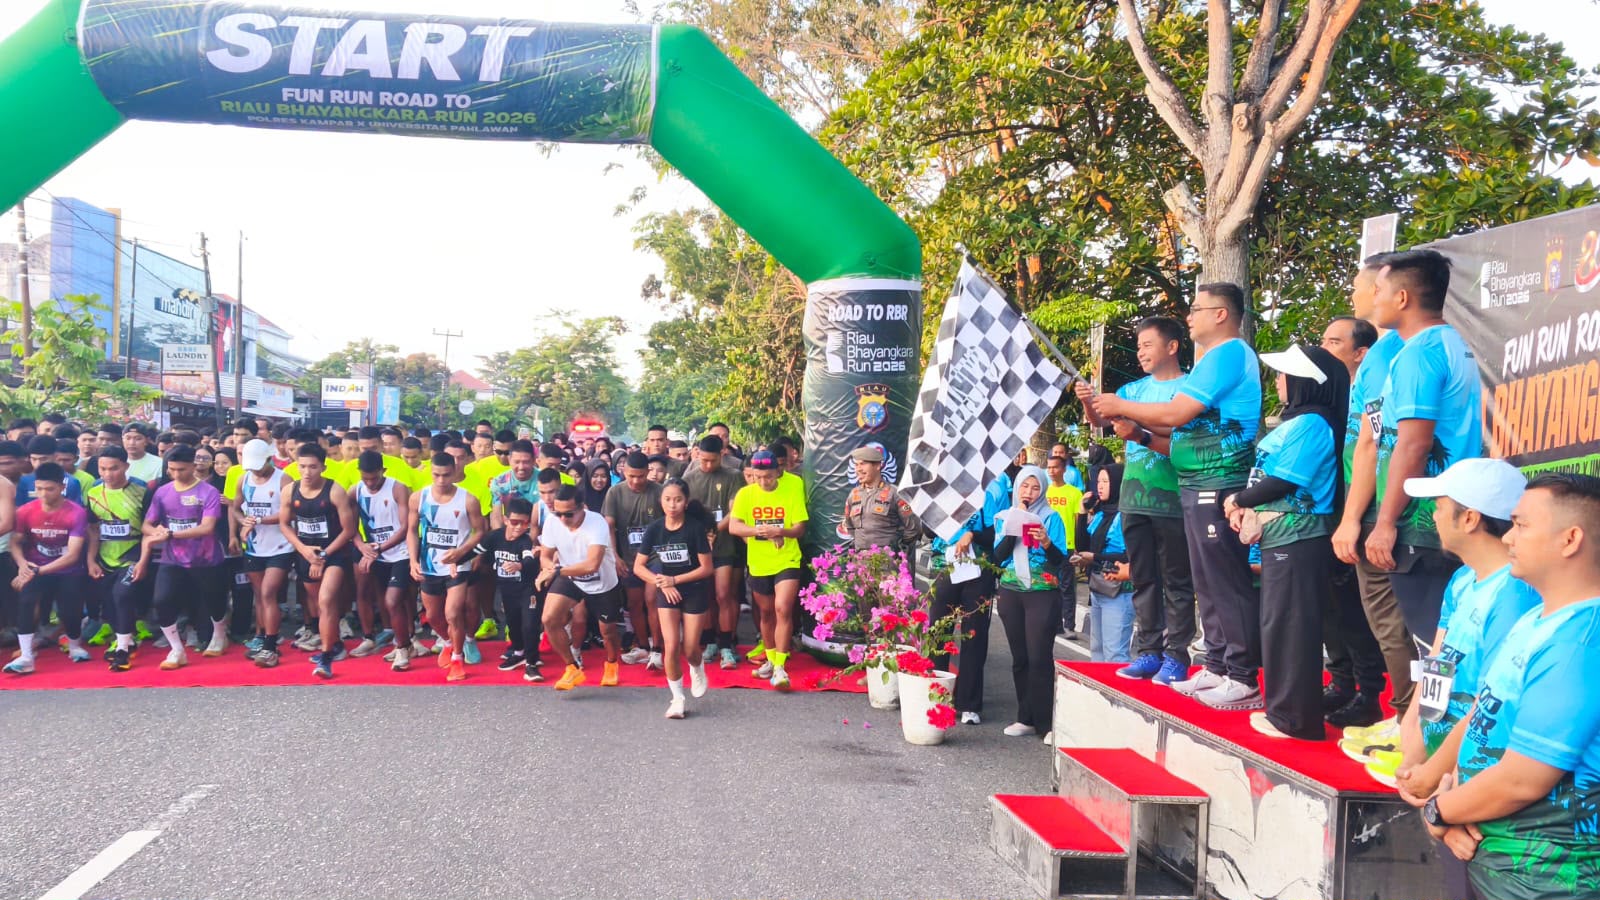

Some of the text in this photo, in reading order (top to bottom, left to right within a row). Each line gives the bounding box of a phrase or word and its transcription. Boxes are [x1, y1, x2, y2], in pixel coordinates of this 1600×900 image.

[206, 12, 536, 82] START
[281, 87, 472, 109] FUN RUN ROAD TO
[220, 100, 537, 124] RIAU BHAYANGKARA RUN 2026
[247, 115, 297, 124] POLRES
[300, 118, 353, 127] KAMPAR
[368, 121, 447, 132] UNIVERSITAS
[451, 125, 519, 134] PAHLAWAN
[1491, 260, 1508, 275] Riau
[1490, 271, 1541, 292] Bhayangkara
[1490, 289, 1530, 308] Run 2026
[828, 303, 908, 321] ROAD TO RBR
[846, 331, 875, 345] Riau
[1502, 309, 1600, 379] FUN RUN RO
[846, 345, 914, 361] Bhayangkara
[847, 359, 906, 372] Run 2026
[1490, 359, 1600, 459] BHAYANG
[752, 506, 785, 519] 898
